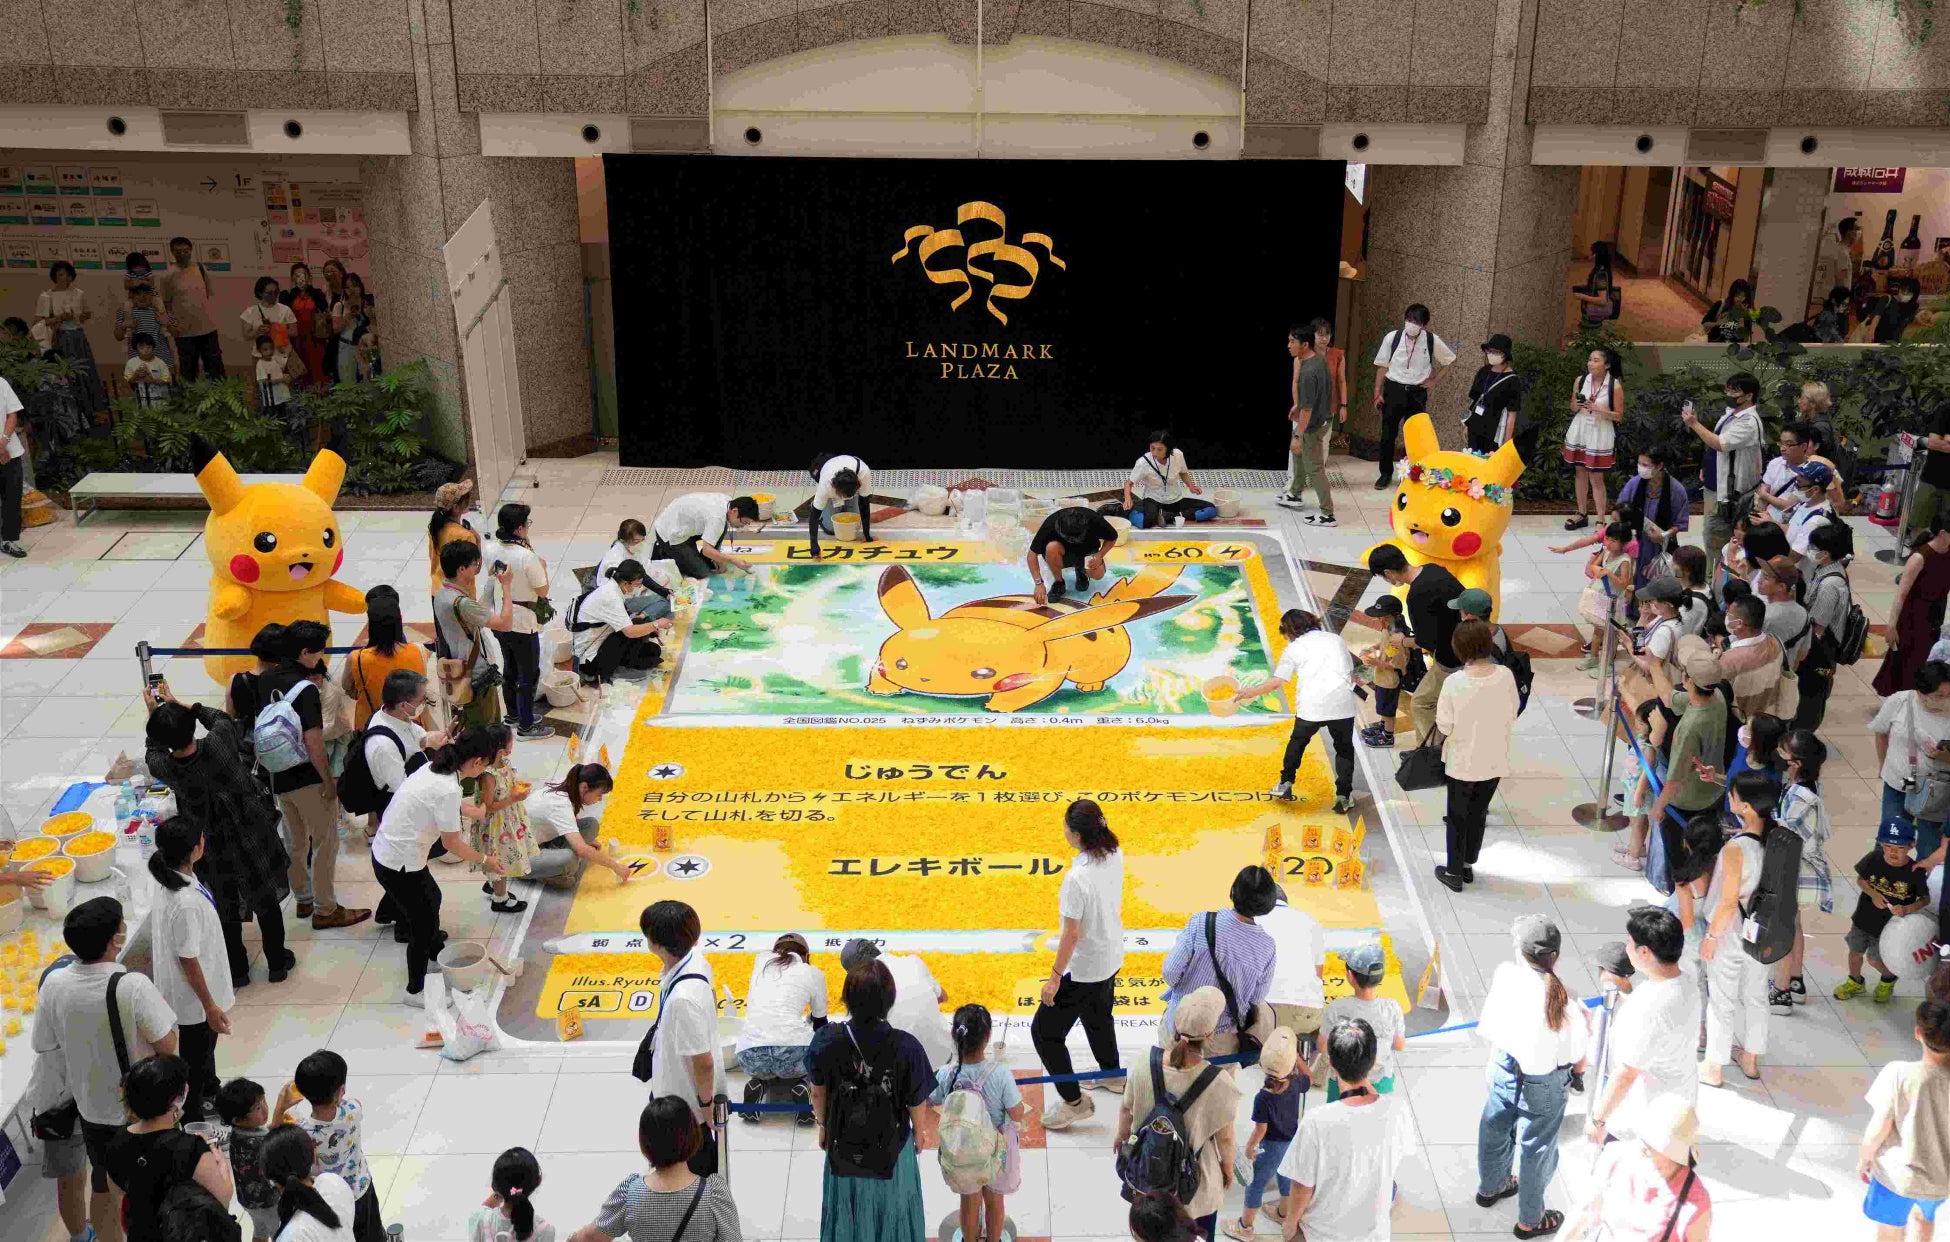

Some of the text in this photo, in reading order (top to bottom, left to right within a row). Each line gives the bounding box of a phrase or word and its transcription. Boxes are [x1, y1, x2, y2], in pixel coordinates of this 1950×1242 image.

[234, 174, 252, 187] 1F
[905, 341, 1053, 359] LANDMARK
[940, 362, 1019, 380] PLAZA
[901, 716, 998, 725] ねずみポケモン
[844, 764, 1007, 780] じゅうでん
[636, 809, 835, 822] そして山札を切る。
[1889, 823, 1900, 836] LA
[827, 857, 1064, 876] エレキボール
[825, 937, 886, 947] 抵力
[578, 995, 601, 1008] sA
[634, 995, 648, 1007] D
